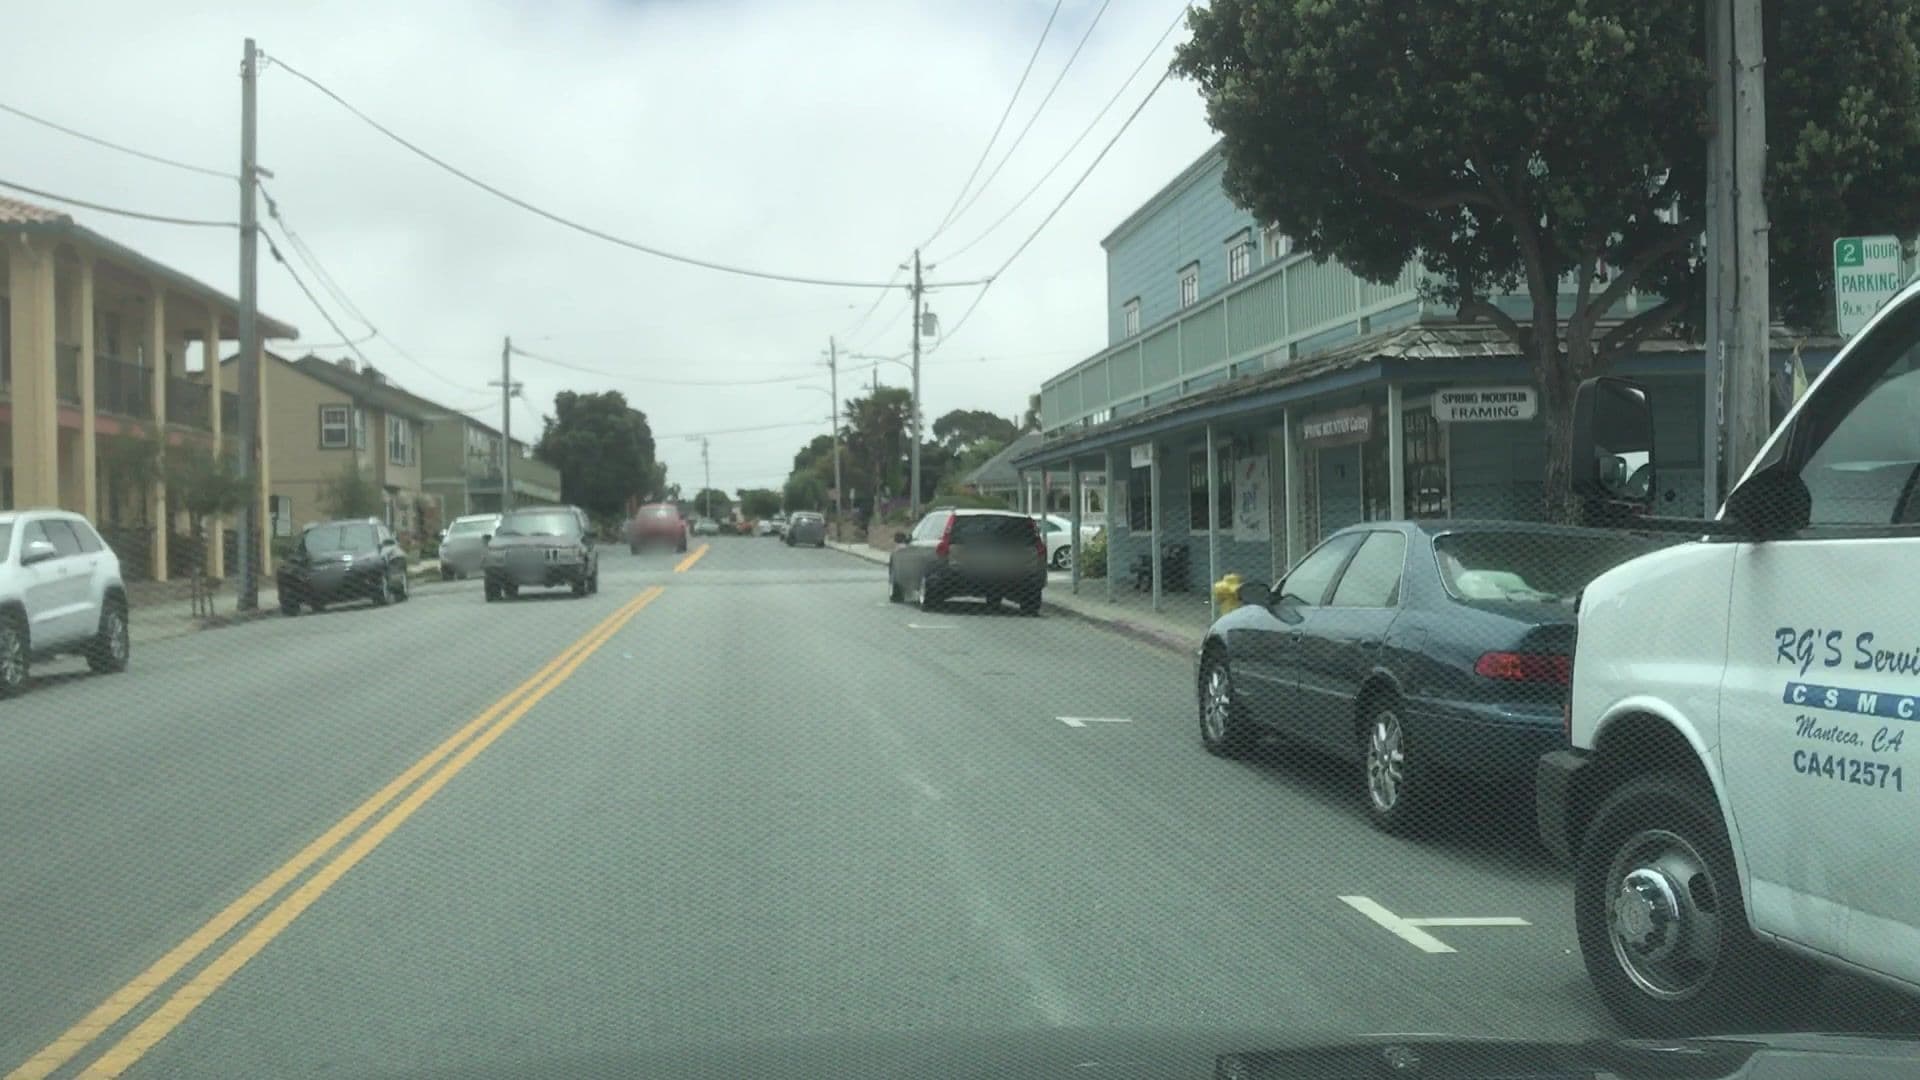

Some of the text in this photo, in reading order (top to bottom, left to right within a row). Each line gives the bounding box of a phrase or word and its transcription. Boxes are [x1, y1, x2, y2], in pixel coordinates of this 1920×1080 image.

[1843, 243, 1896, 262] 2 HOUR
[1841, 272, 1897, 293] PARKING
[1441, 391, 1527, 405] SPRING MOUNTAIN
[1451, 405, 1519, 419] FRAMING
[1871, 726, 1905, 752] CA
[1793, 750, 1903, 792] CA412571
